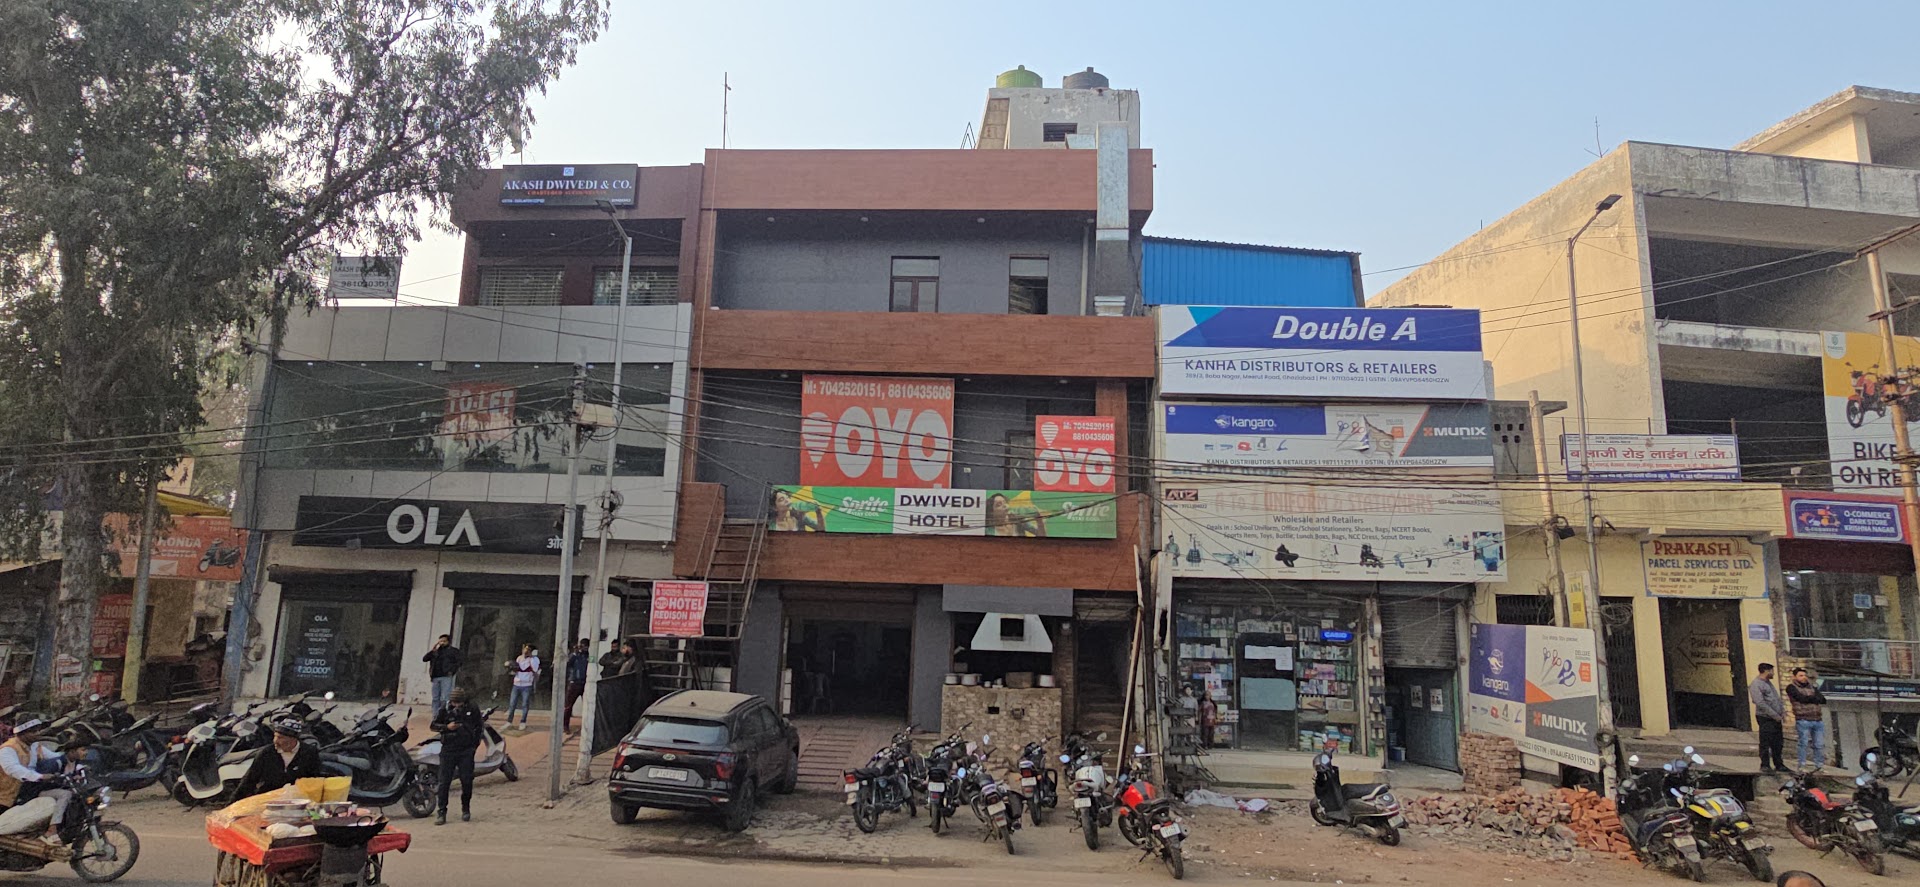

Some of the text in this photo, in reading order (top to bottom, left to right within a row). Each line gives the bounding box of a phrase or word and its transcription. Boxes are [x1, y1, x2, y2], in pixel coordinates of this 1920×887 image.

[504, 180, 632, 190] AKASH DWIVEDI & CO.
[1272, 315, 1417, 341] Double A
[1185, 359, 1438, 374] KANHA DISTRIBUTORS & RETAILERS
[804, 381, 952, 400] M: 7042520151, 8810435606
[1073, 421, 1114, 431] 7042520151
[1231, 416, 1275, 430] kangaro
[1072, 432, 1114, 442] 8810435606
[1434, 427, 1488, 436] MUNIX
[834, 406, 950, 482] OYO
[1570, 446, 1618, 459] बलाजी
[1623, 448, 1644, 459] रोड
[1038, 448, 1114, 486] OYO
[1840, 466, 1920, 486] ON RET
[838, 494, 1110, 520] Sprite DWIVEDI Sprite
[386, 504, 482, 546] OLA
[909, 514, 968, 528] HOTEL
[1273, 516, 1313, 524] Wholesale
[1332, 516, 1364, 524] Retailers
[1652, 540, 1732, 556] PRAKASH
[1648, 558, 1754, 569] PARCEL SERVICES LTD.
[668, 598, 703, 610] HOTEL
[654, 610, 688, 620] REDISON
[1482, 674, 1510, 692] kangaro
[1541, 713, 1588, 736] MUNIX
